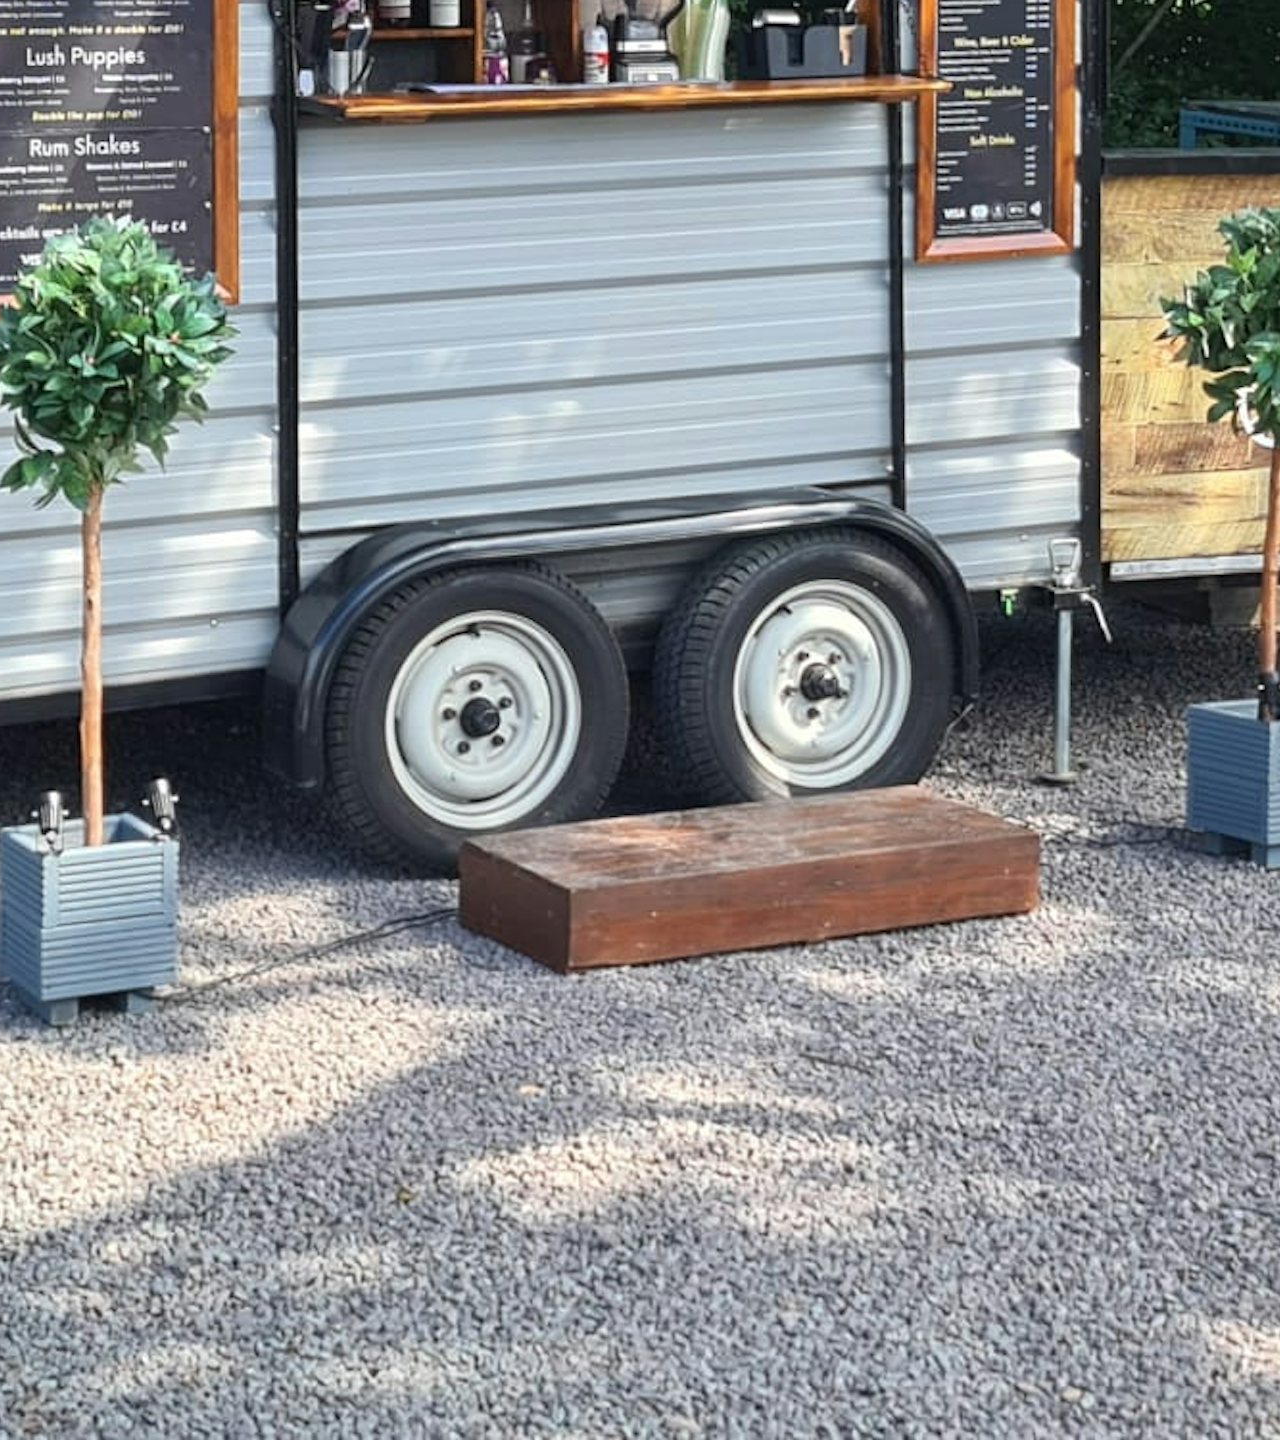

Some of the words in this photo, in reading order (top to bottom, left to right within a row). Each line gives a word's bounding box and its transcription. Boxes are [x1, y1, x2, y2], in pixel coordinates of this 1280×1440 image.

[26, 47, 65, 67] Lush
[71, 46, 146, 72] Puppies
[29, 138, 69, 157] Rum
[74, 132, 140, 156] Shakes
[151, 221, 168, 233] for
[171, 220, 188, 233] £4
